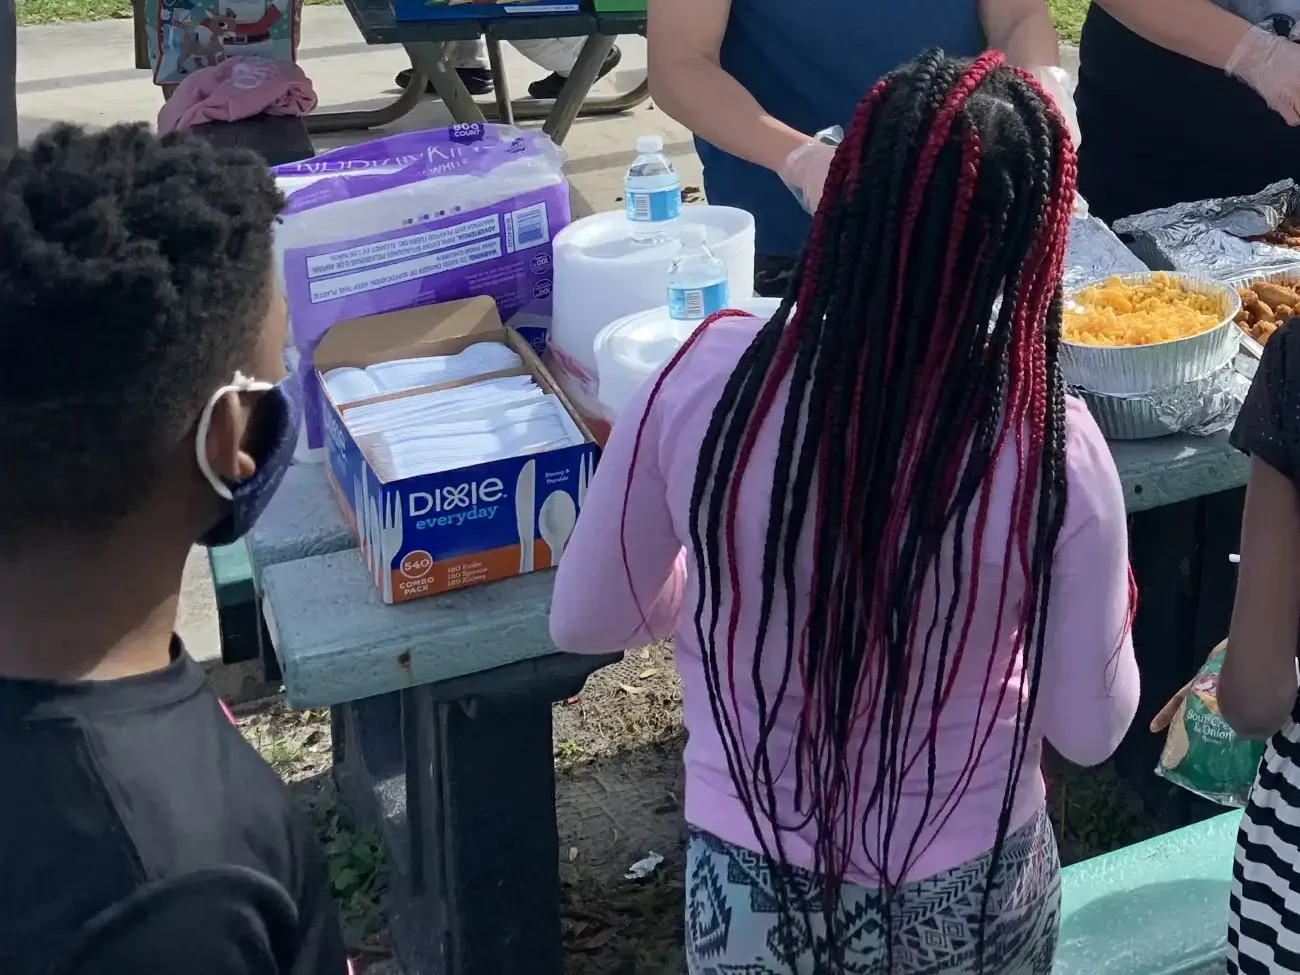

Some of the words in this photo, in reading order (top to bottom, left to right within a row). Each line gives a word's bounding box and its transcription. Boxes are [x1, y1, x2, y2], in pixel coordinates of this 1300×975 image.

[454, 129, 481, 137] COUNT
[416, 505, 498, 529] everyday
[404, 559, 430, 571] 540
[400, 577, 434, 589] COMBO
[404, 584, 429, 595] PACK
[1187, 709, 1210, 723] Sour
[1211, 717, 1230, 730] Cre
[1193, 722, 1201, 732] &
[1203, 725, 1232, 741] Onion
